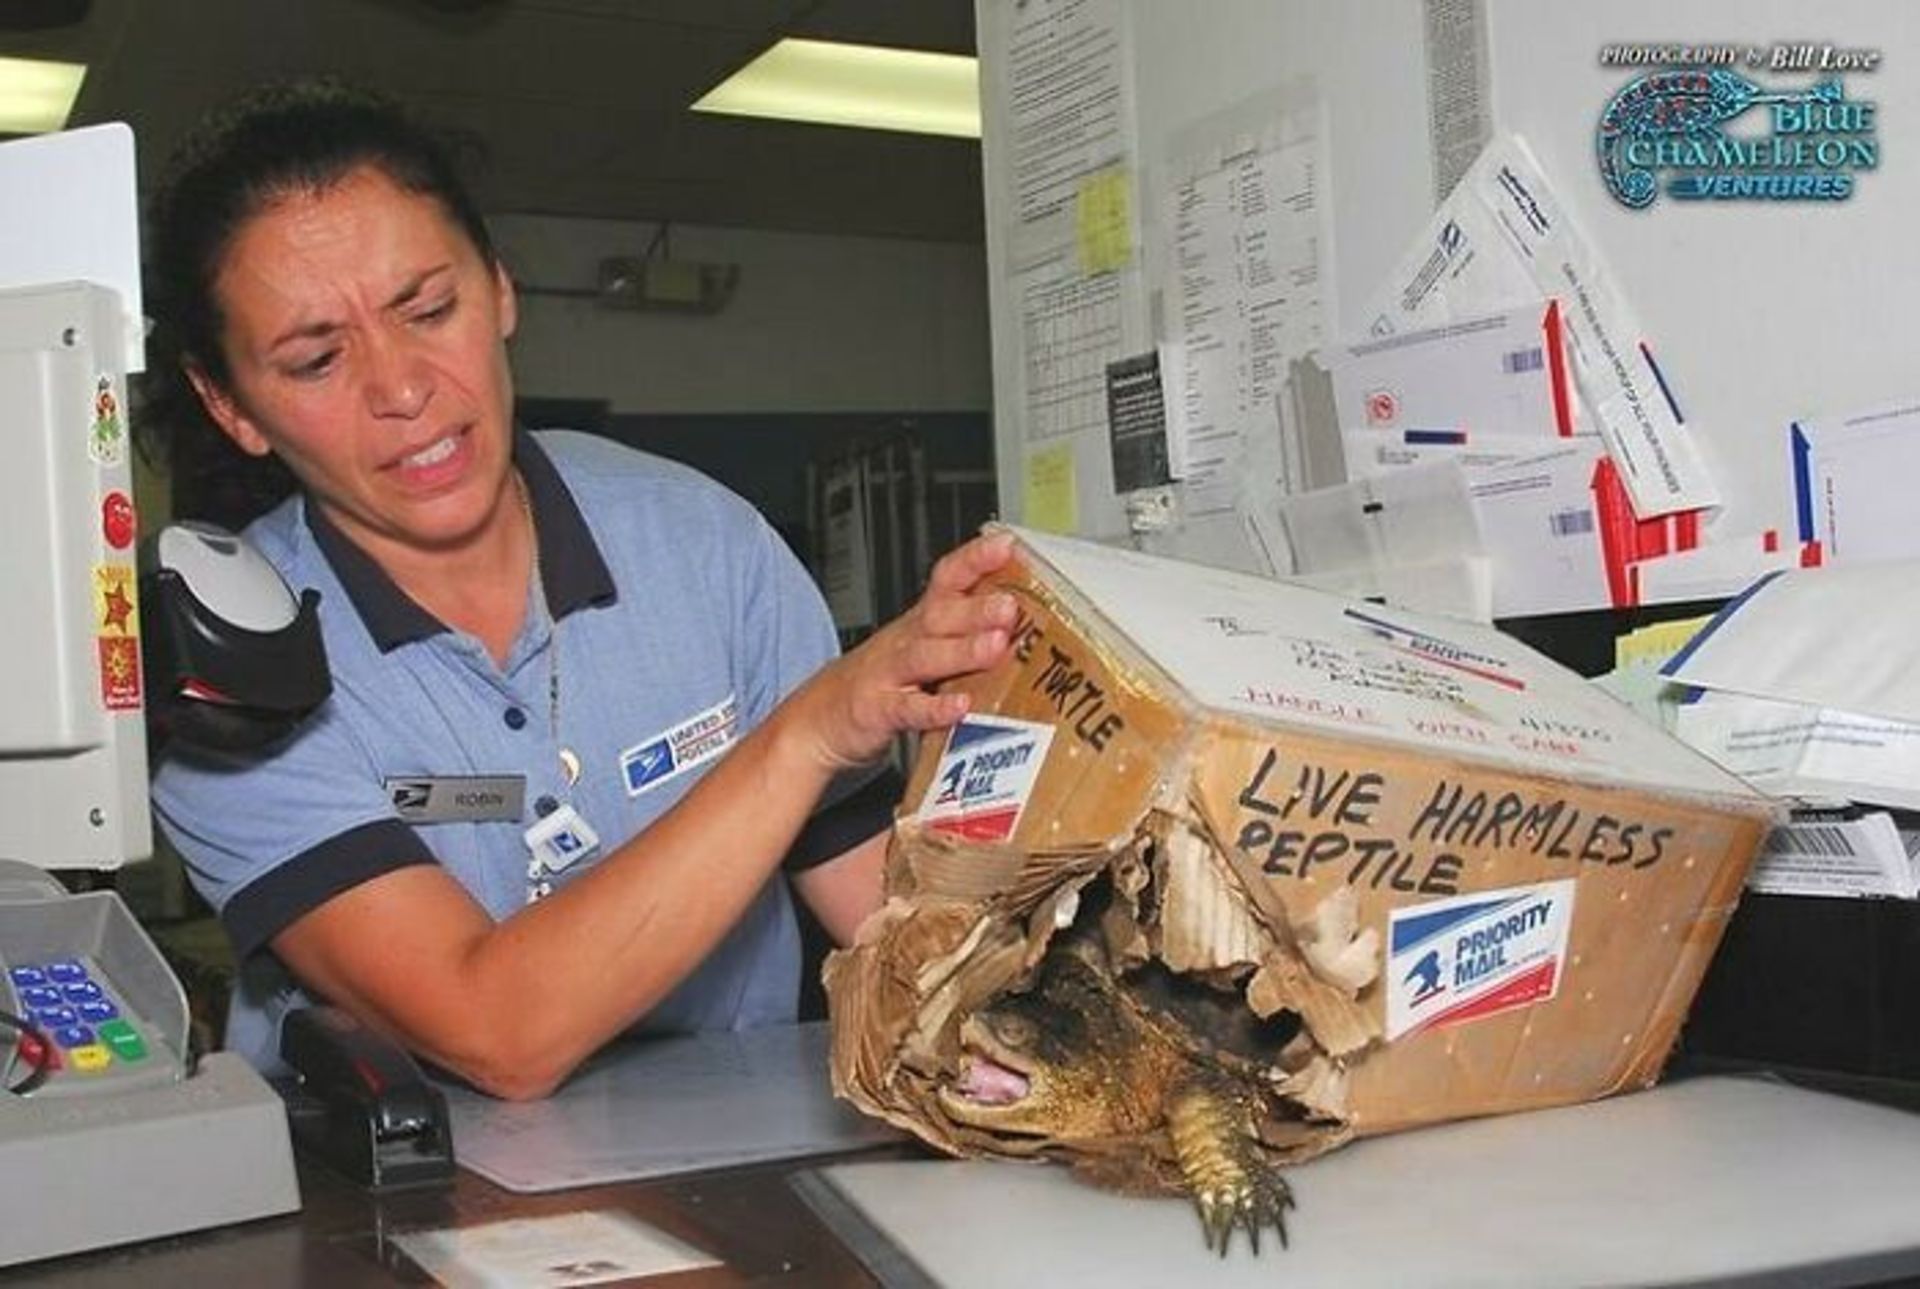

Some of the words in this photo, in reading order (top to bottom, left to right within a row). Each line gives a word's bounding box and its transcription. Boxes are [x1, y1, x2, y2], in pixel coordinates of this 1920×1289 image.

[1238, 747, 1385, 824] LIVE
[1408, 780, 1674, 870] HARMLESS
[1455, 900, 1553, 961] PRIORITY
[1453, 947, 1507, 986] MAIL
